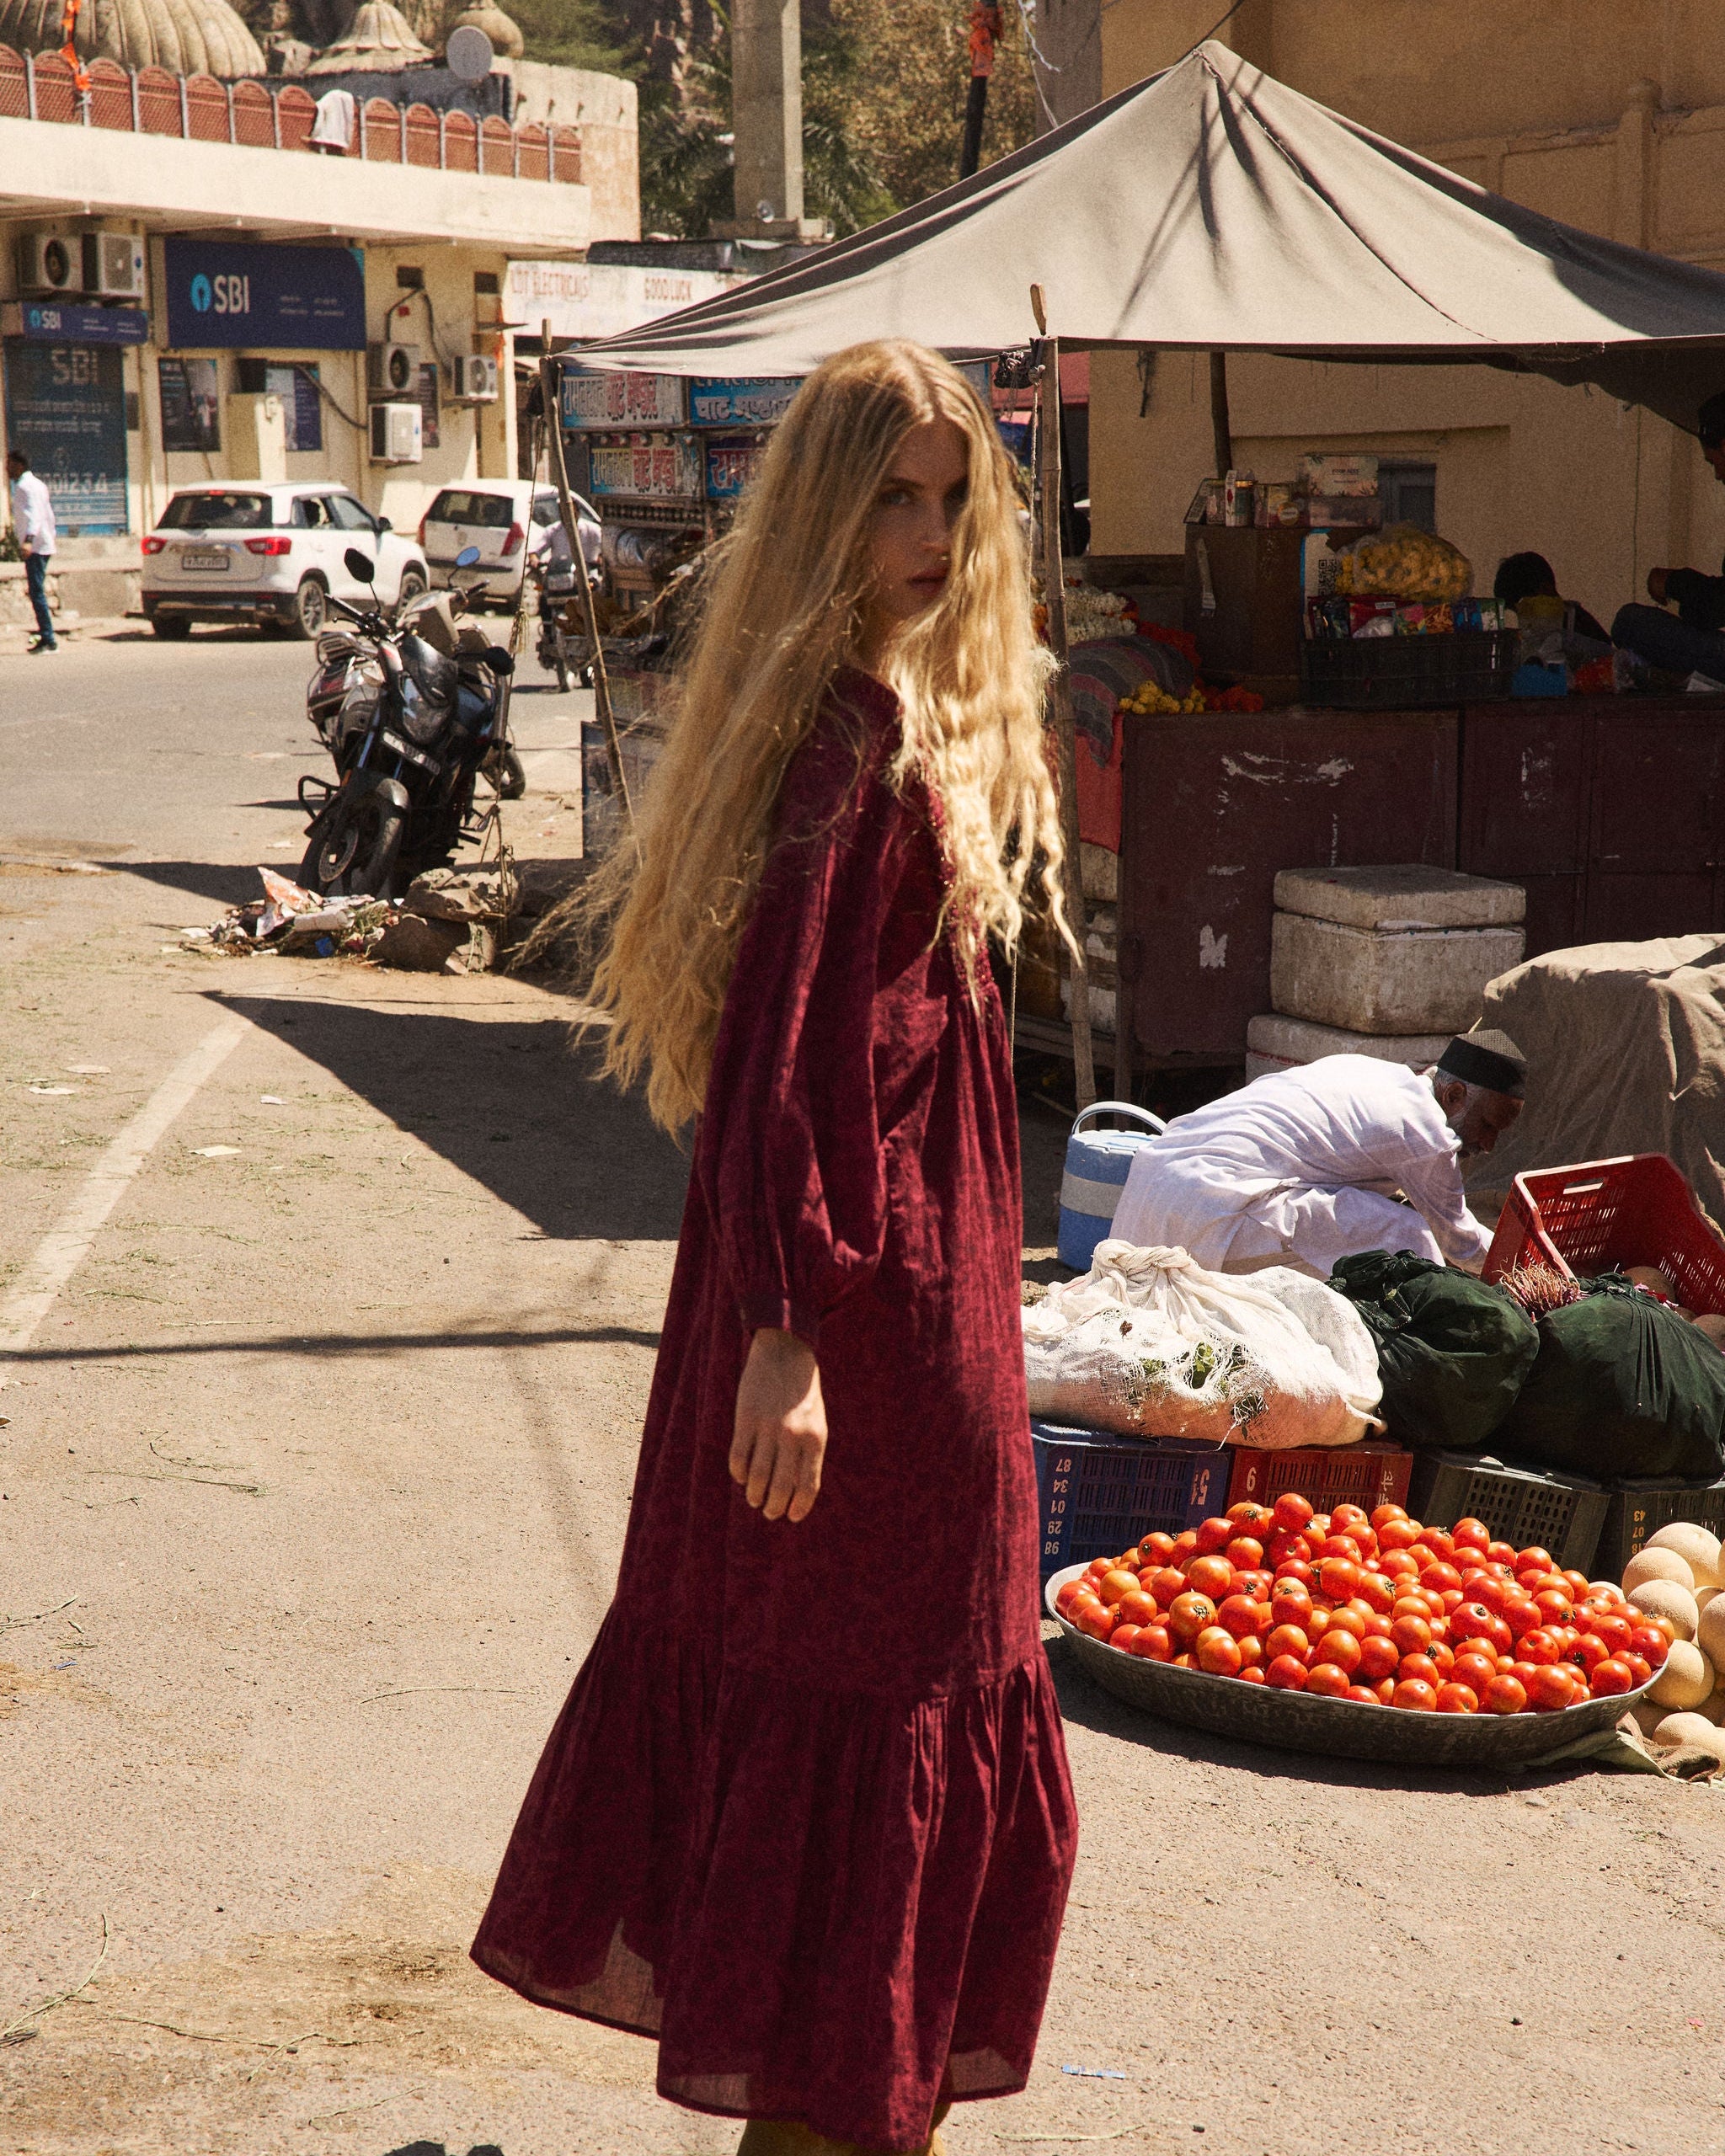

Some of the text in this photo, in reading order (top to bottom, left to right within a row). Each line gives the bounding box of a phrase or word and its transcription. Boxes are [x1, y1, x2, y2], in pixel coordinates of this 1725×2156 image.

[213, 274, 251, 314] SBI
[41, 310, 61, 329] SBI
[51, 348, 99, 386] SBI
[1055, 1458, 1072, 1472] 87
[1052, 1479, 1069, 1493] 34
[1050, 1499, 1065, 1514] 01
[1633, 1509, 1646, 1523] 43
[1047, 1520, 1063, 1534] 29
[1632, 1526, 1644, 1539] 07
[1044, 1540, 1060, 1556] 98
